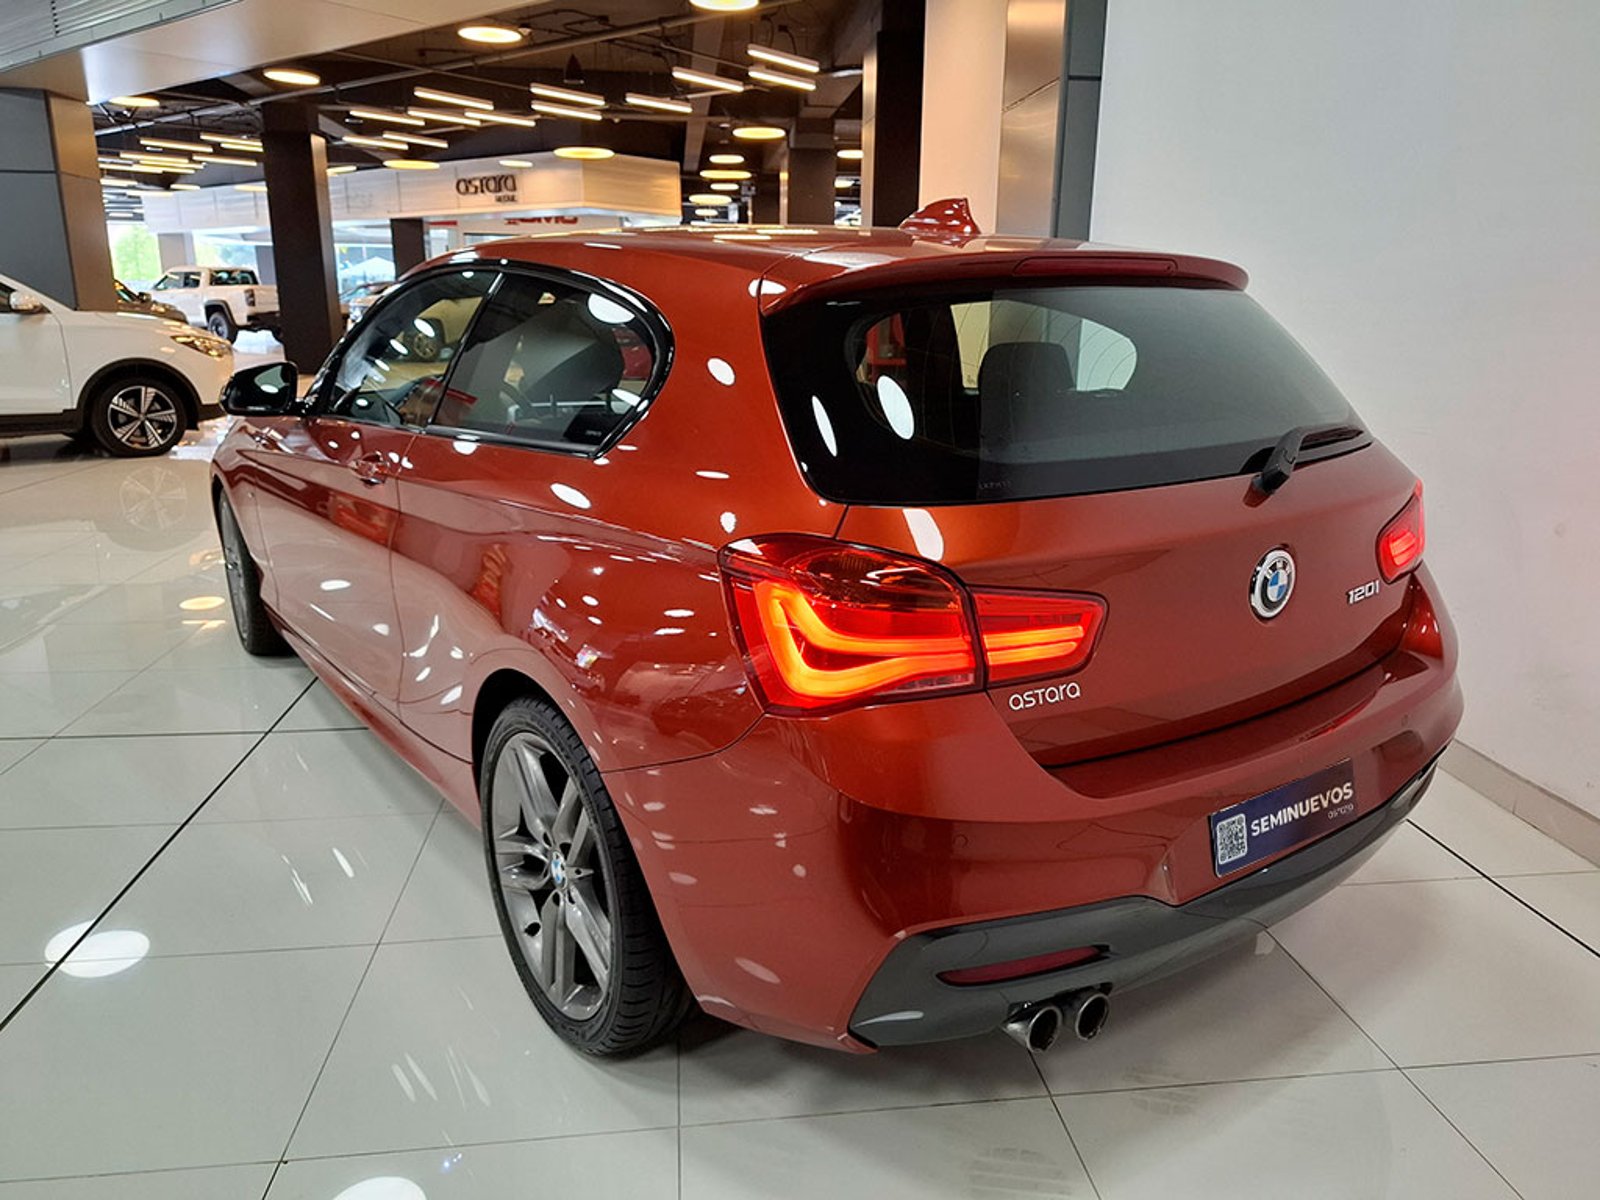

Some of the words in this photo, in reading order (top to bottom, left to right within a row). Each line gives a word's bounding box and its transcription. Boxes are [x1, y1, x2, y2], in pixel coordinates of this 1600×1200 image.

[455, 174, 517, 195] astara
[1008, 682, 1081, 711] astara
[1250, 782, 1354, 837] SEMINUEVOS
